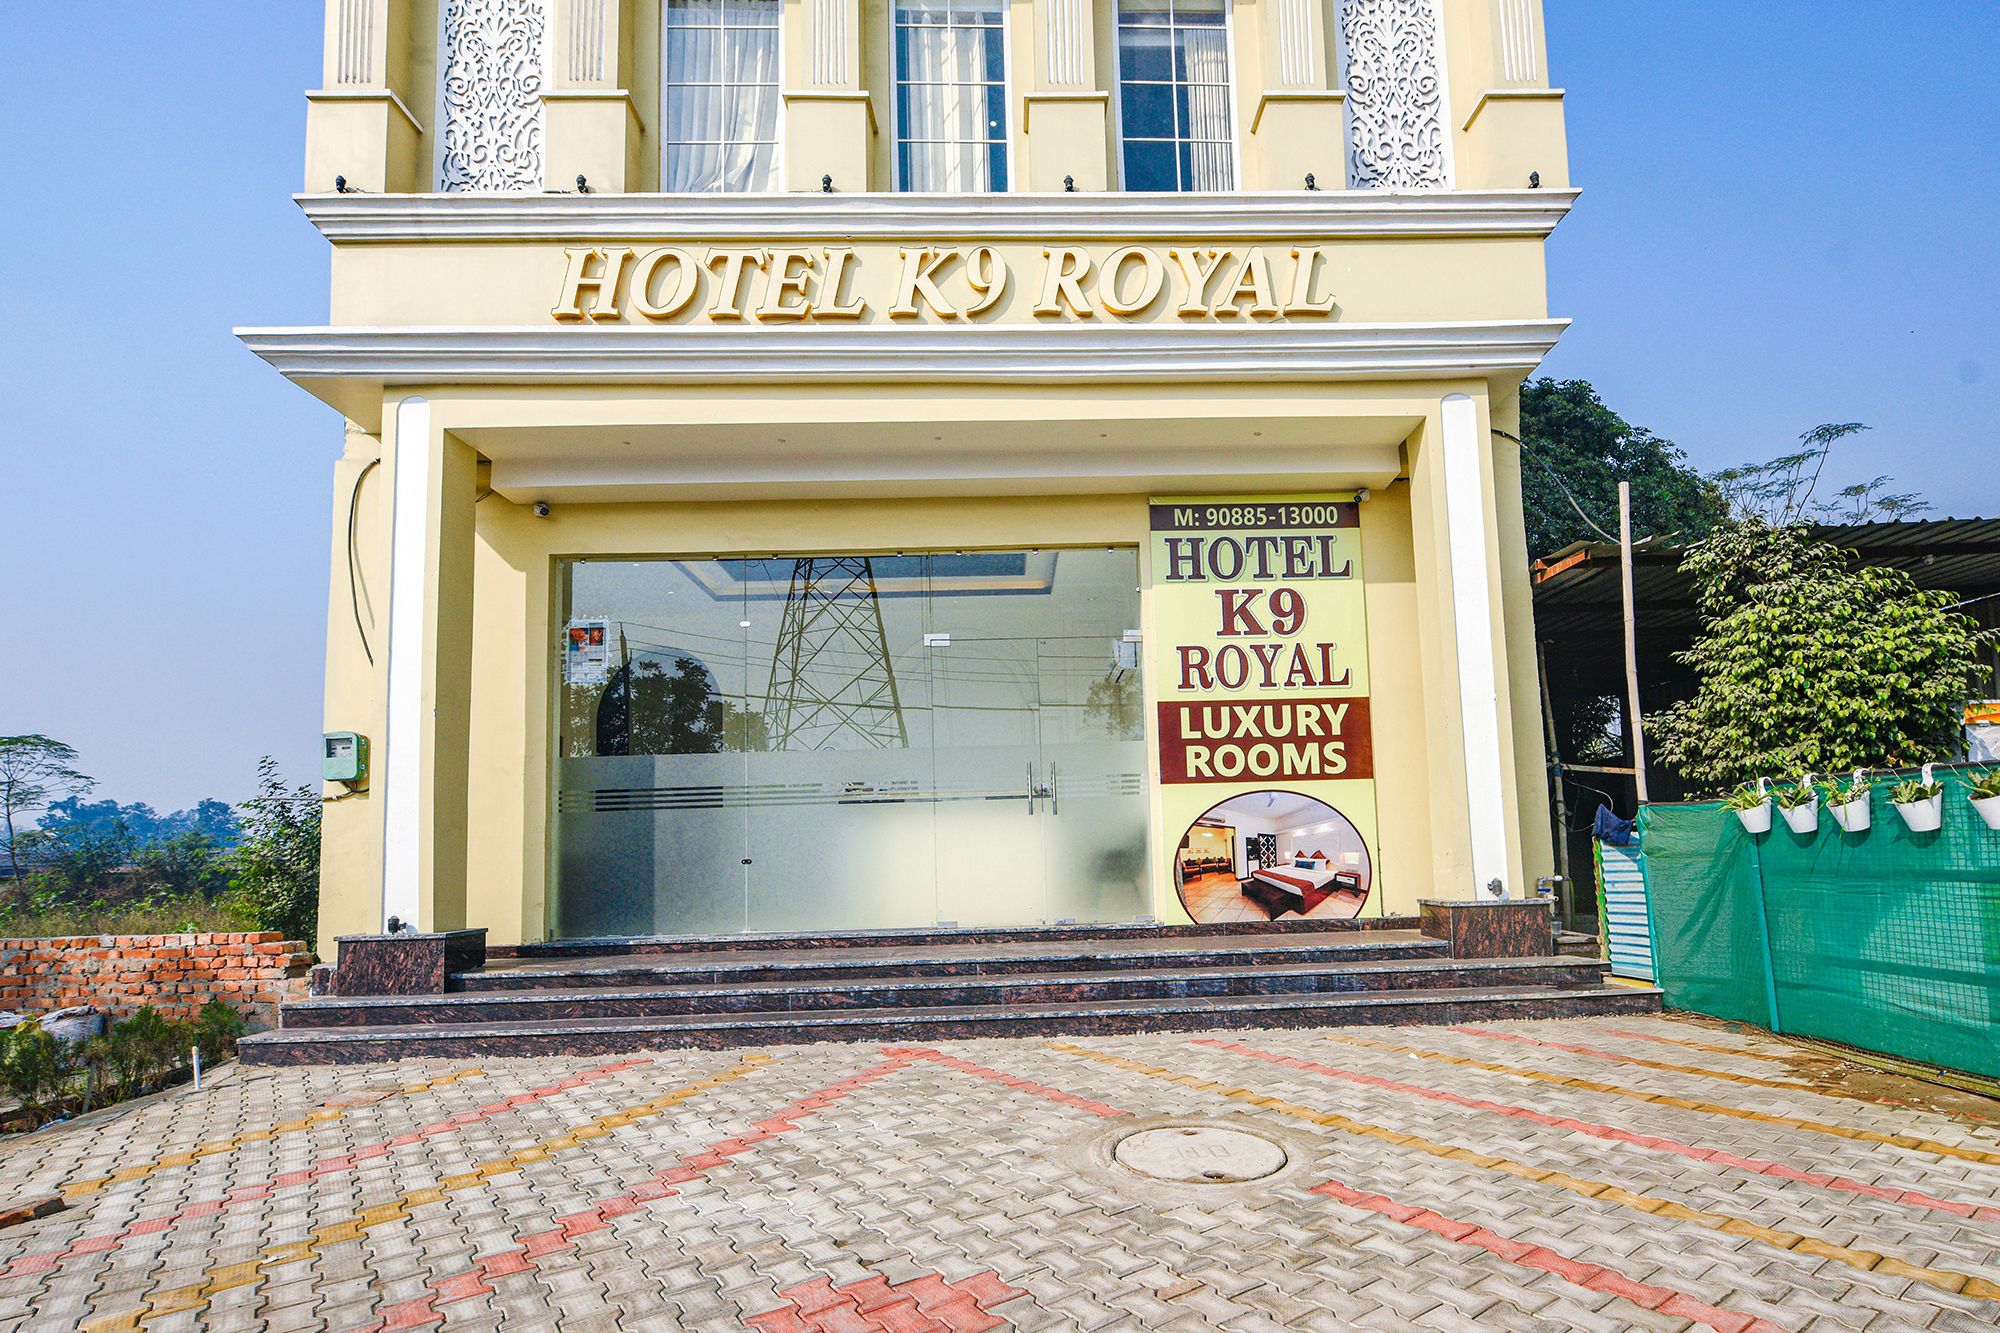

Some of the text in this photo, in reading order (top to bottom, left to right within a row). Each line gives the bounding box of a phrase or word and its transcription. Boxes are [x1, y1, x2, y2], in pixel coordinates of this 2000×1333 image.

[550, 245, 1336, 321] HOTEL K9 ROYAL
[1173, 506, 1339, 527] M: 90885-13000
[1164, 535, 1352, 581] HOTEL
[1214, 587, 1307, 637] K9
[1176, 642, 1351, 691] ROYAL
[1180, 703, 1349, 739] LUXURY
[1185, 741, 1347, 778] ROOMS
